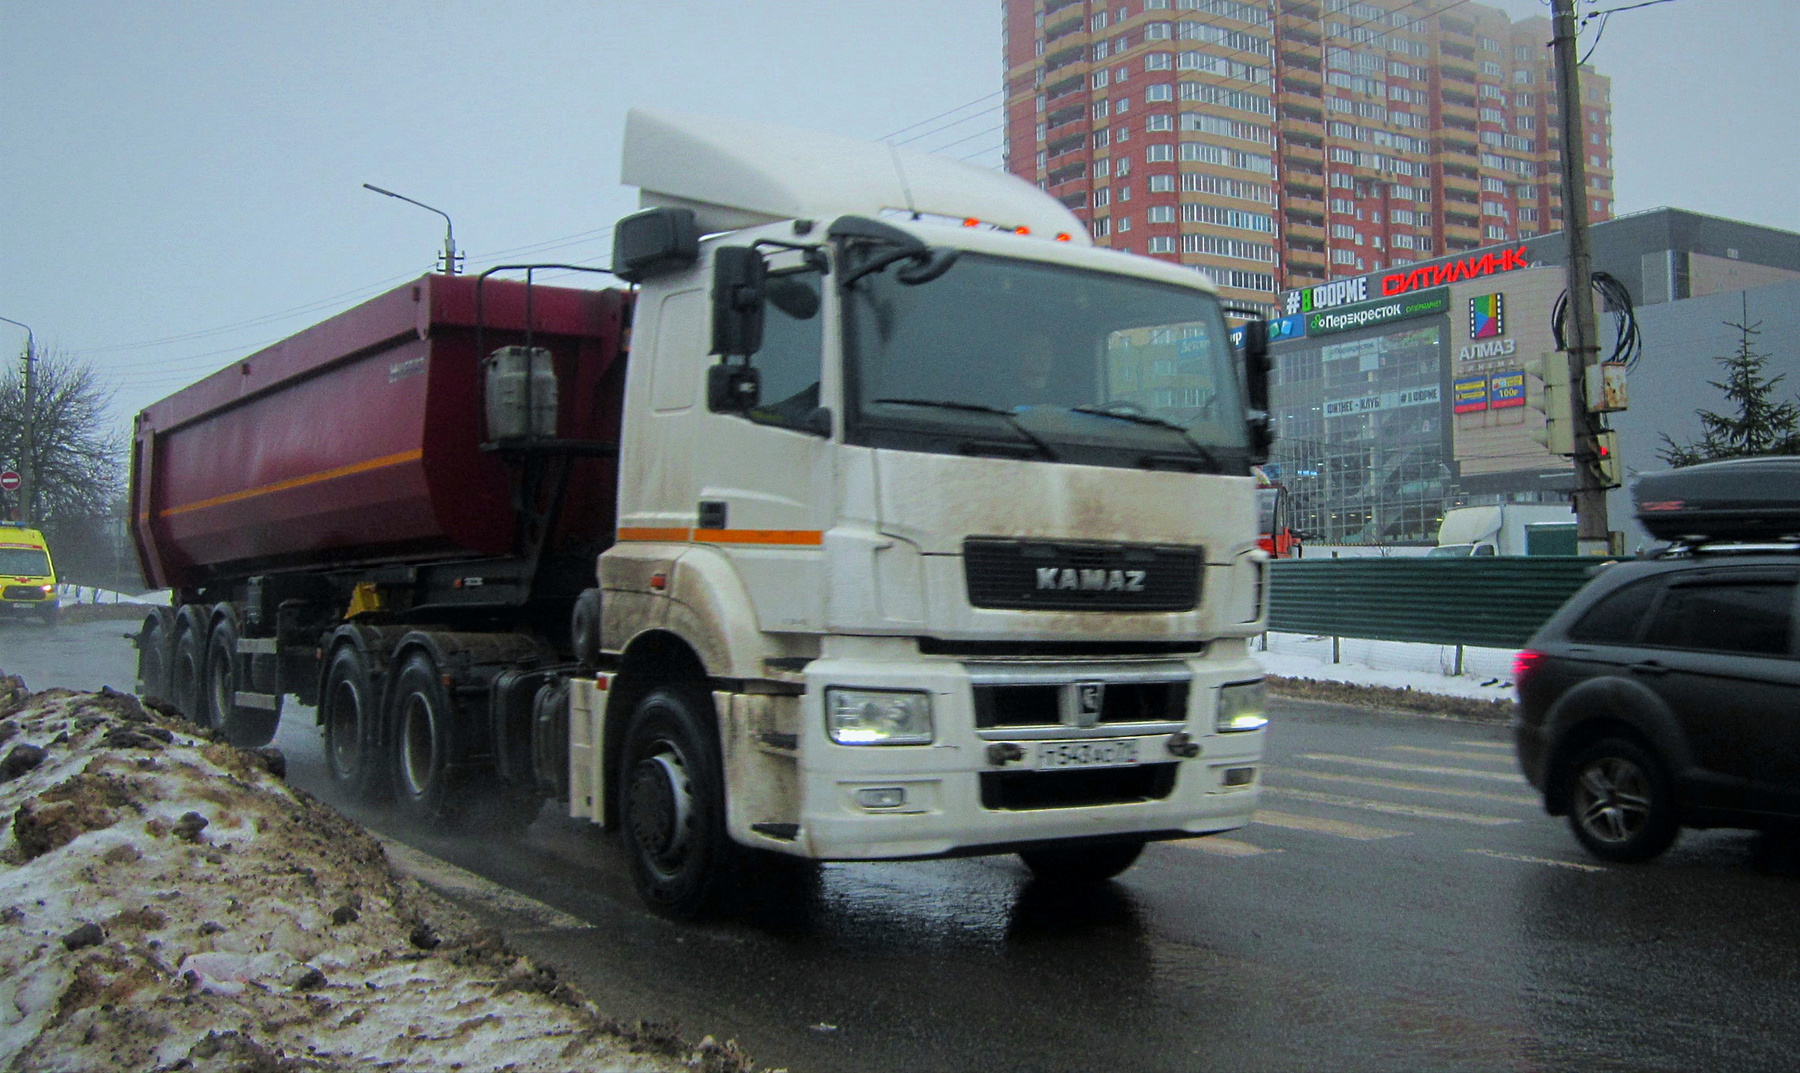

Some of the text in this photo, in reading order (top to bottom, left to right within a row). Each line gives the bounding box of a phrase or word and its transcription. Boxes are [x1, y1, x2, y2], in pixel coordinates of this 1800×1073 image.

[1382, 246, 1527, 296] СИТИЛИНК
[1459, 339, 1516, 361] АЛМАЗ
[1036, 567, 1146, 591] KAMAZ
